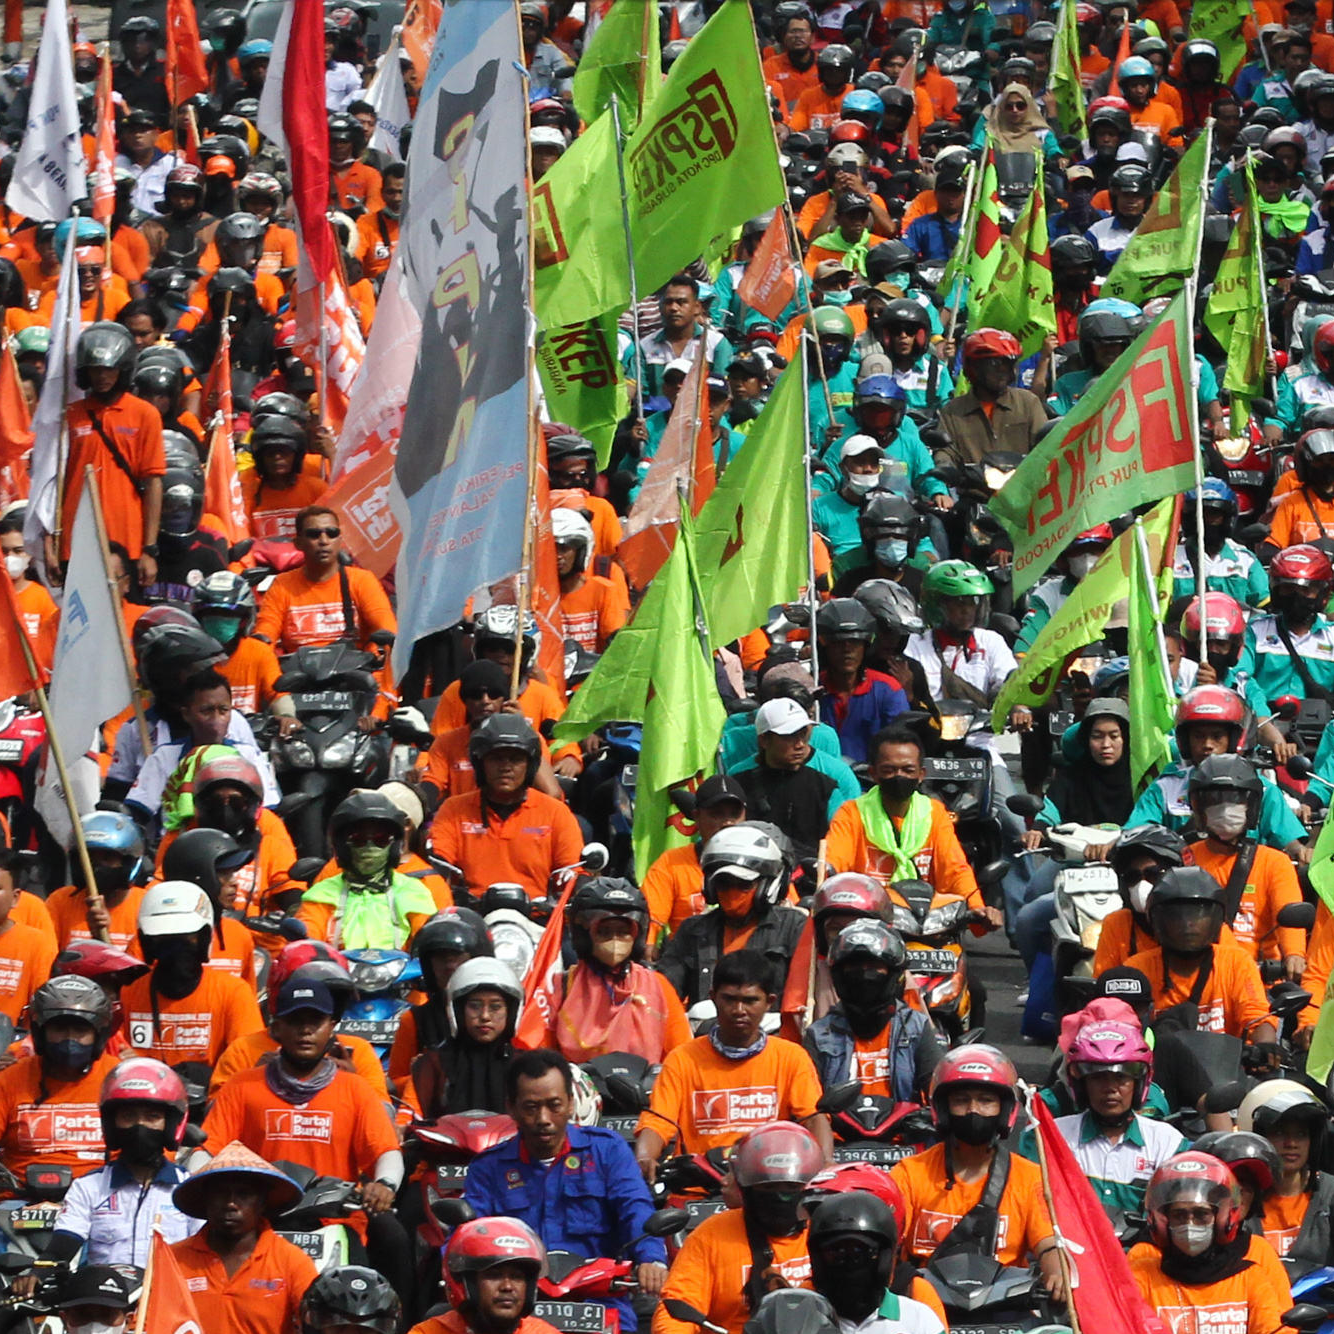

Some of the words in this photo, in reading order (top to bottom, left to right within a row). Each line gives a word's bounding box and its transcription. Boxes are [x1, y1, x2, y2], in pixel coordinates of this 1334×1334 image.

[539, 343, 567, 396] SURABAYA
[132, 1023, 146, 1043] 6
[175, 1023, 209, 1038] Partai
[175, 1035, 209, 1049] Buruh
[729, 1093, 777, 1107] Partai
[293, 1112, 330, 1128] Partai
[729, 1105, 777, 1120] Buruh
[292, 1124, 330, 1139] Buruh
[1198, 1307, 1248, 1325] Partai
